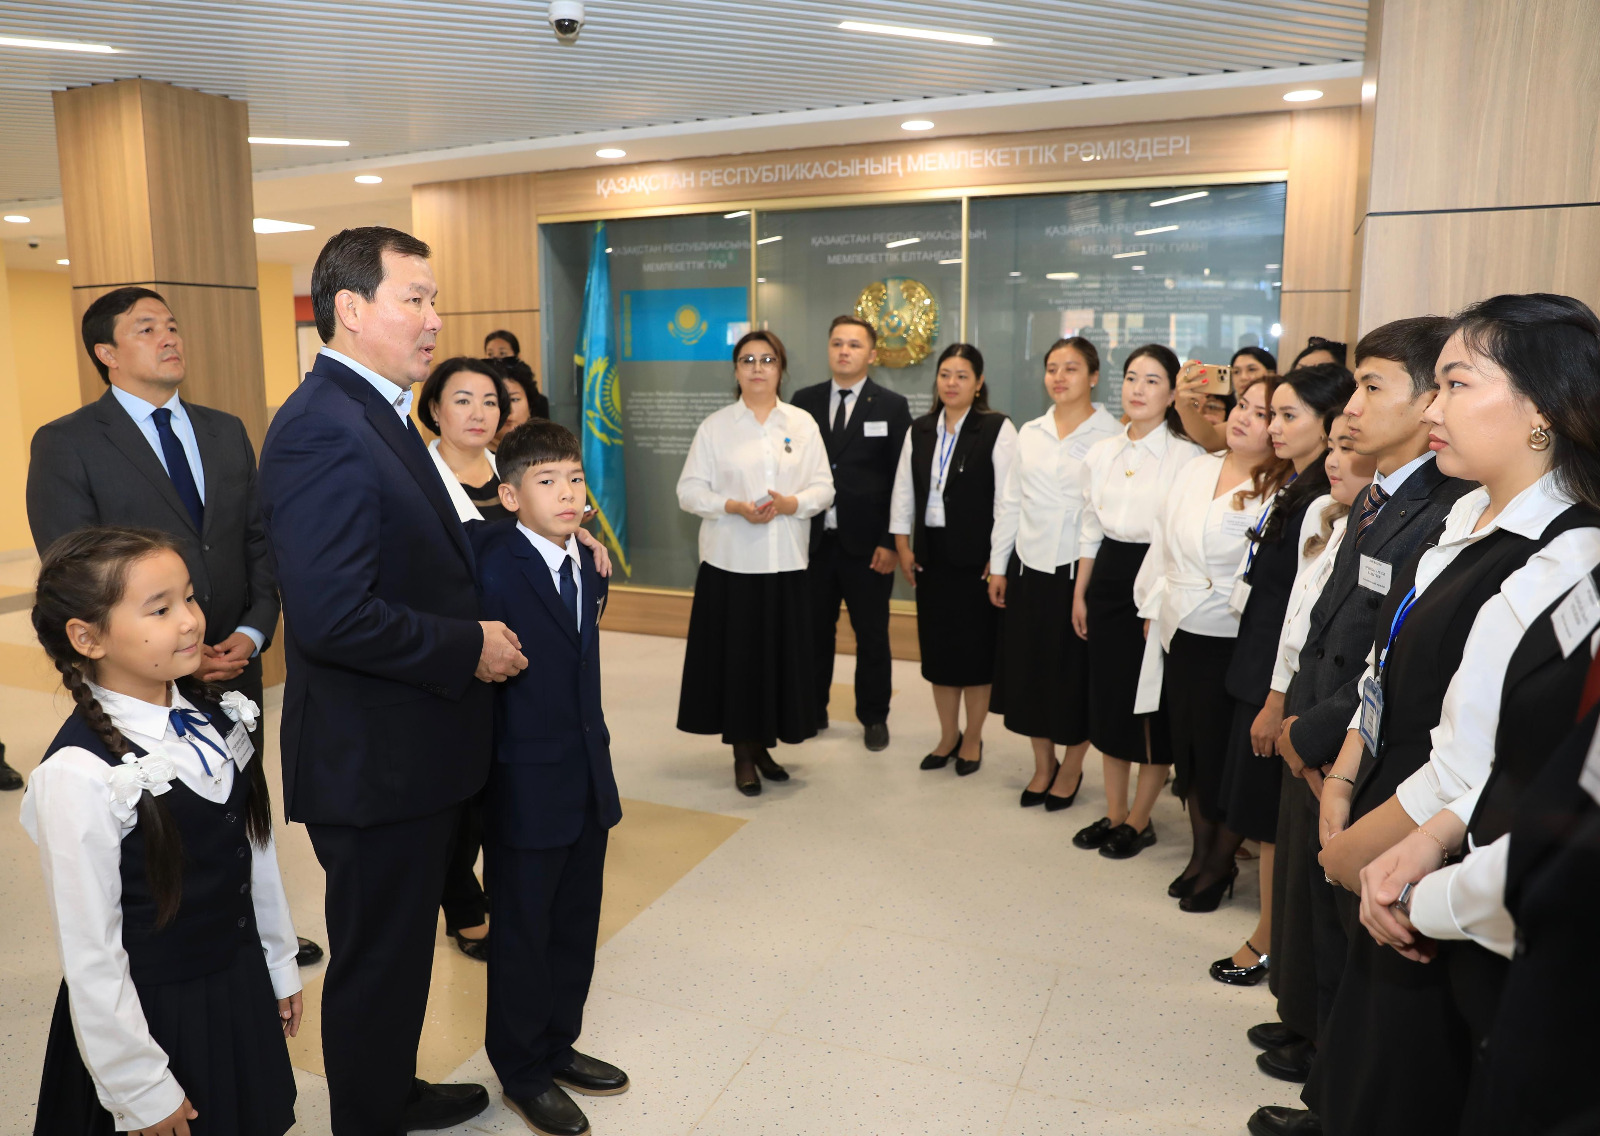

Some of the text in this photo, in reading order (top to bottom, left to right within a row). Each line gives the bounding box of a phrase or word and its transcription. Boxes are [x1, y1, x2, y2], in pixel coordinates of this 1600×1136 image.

[595, 135, 1190, 198] ҚАЗАҚСТАН РЕСПУБЛИКАСЫНЫҢ МЕМЛЕКЕТТІК РӘМІЗДЕРІ
[872, 228, 987, 245] РЕСПУБЛИКАСЫЫҢ
[663, 239, 752, 254] РЕСПУБЛИКАСЫН
